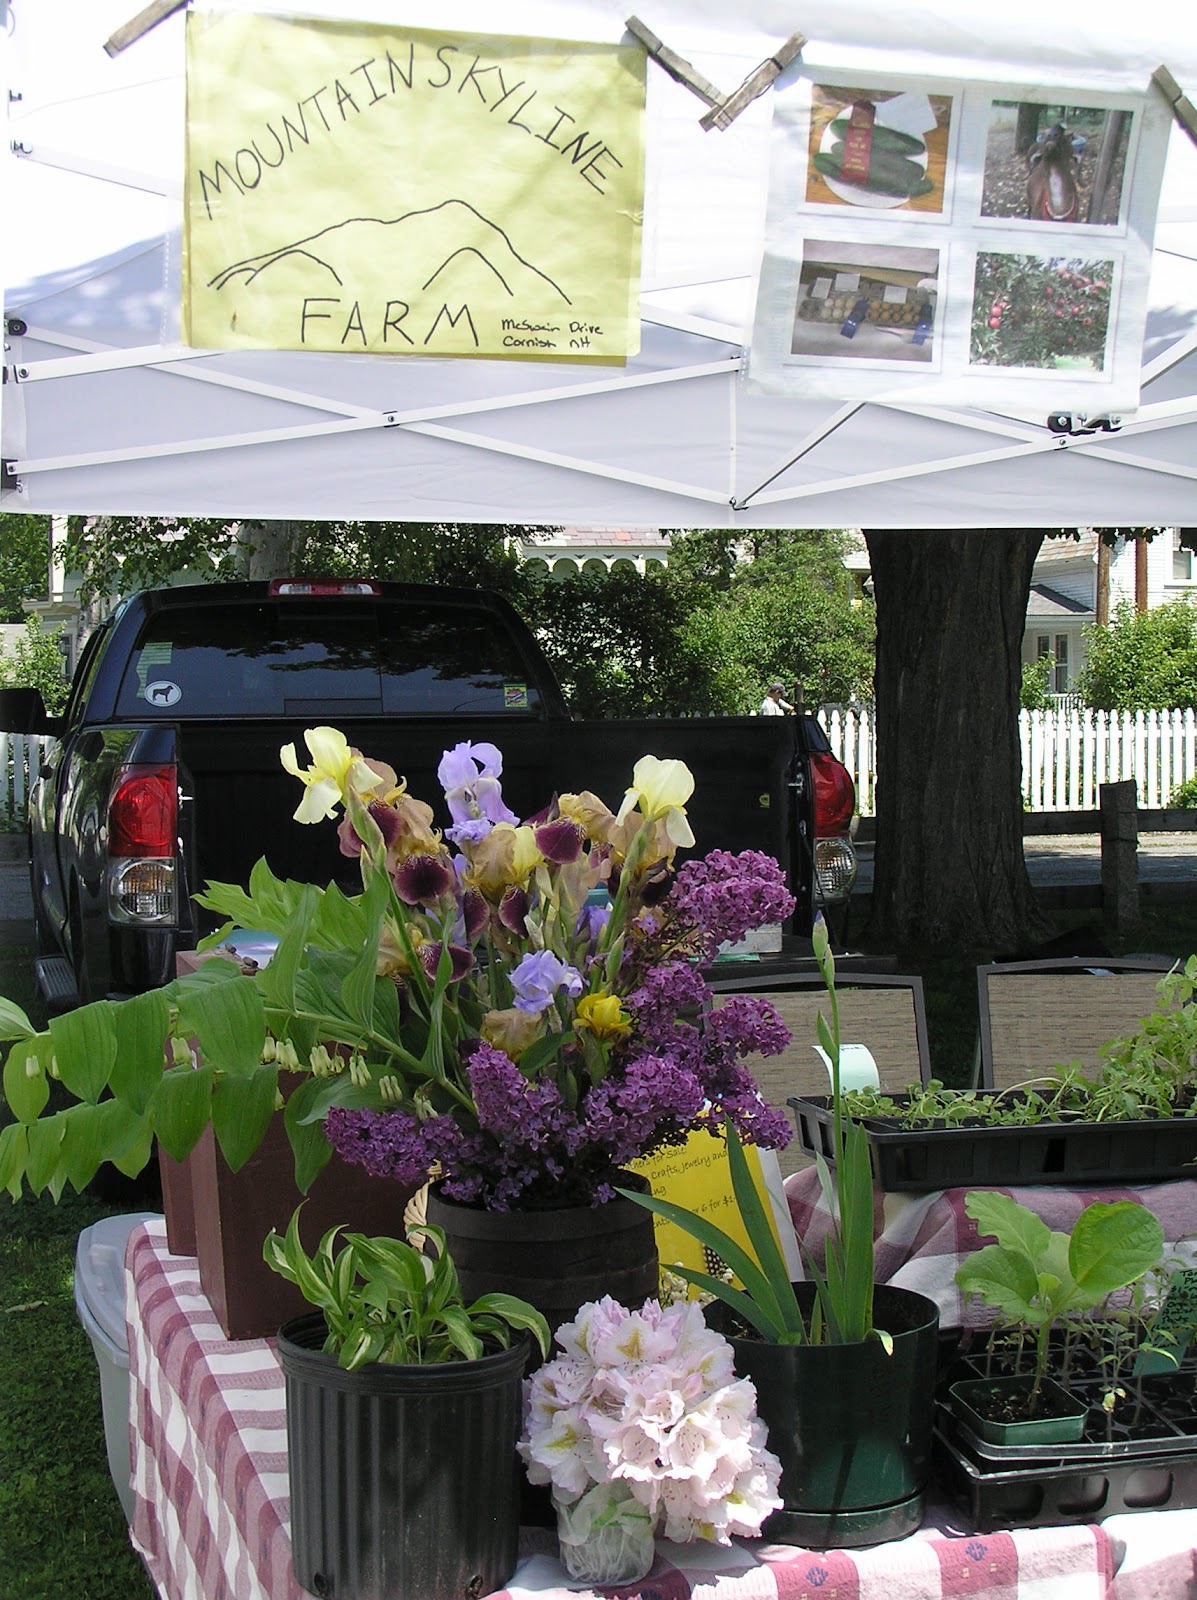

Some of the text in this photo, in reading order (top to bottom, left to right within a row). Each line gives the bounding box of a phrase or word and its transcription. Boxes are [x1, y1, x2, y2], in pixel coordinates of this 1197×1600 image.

[199, 43, 623, 220] MOUNTAIN SKYLINE
[300, 297, 479, 347] FARM
[569, 321, 604, 335] Drive
[502, 335, 557, 348] Cornish
